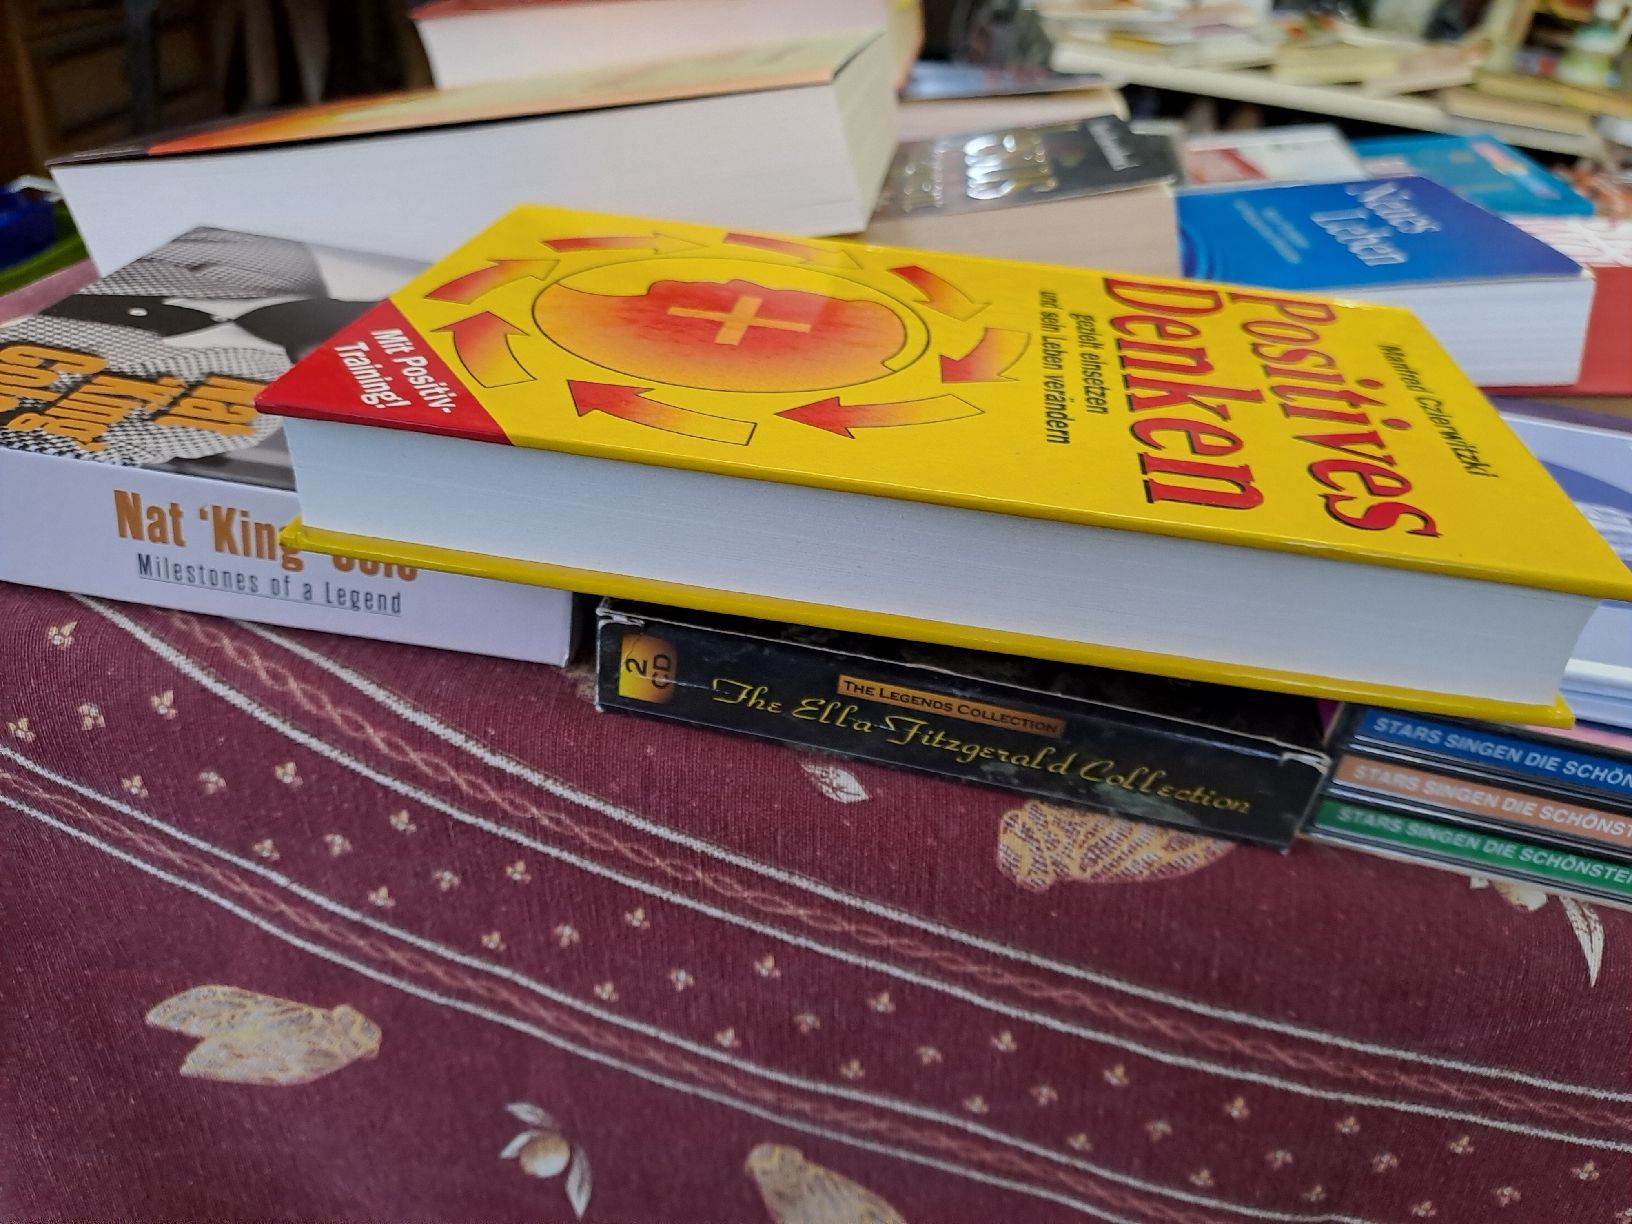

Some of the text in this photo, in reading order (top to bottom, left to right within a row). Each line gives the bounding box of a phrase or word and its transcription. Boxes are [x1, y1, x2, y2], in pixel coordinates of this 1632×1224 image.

[1310, 207, 1408, 267] Leben
[334, 341, 411, 409] Training!
[371, 328, 457, 413] Mit Positiv-
[1040, 291, 1075, 445] und sein Leben verändern
[1069, 311, 1110, 415] gezielt einsetzen
[1377, 344, 1434, 393] Manfred
[1103, 277, 1265, 510] Denken
[1226, 292, 1442, 539] Positives
[114, 490, 186, 547] Nat
[137, 553, 401, 613] Milestones of a Legend
[625, 657, 647, 677] 2
[651, 654, 671, 690] CD
[843, 680, 1059, 733] THE LEGENDS COLLECTION
[712, 678, 1251, 815] The Ella Fitzgerald Collection
[1373, 717, 1442, 745] STARS
[1443, 733, 1524, 763] SINGEN
[1524, 752, 1562, 772] DIE
[1353, 765, 1421, 791] STARS
[1423, 780, 1499, 809] SINGEN
[1502, 797, 1538, 817] DIE
[1337, 807, 1401, 833] STARS
[1405, 822, 1481, 849] SINGEN
[1482, 840, 1518, 859] DIE
